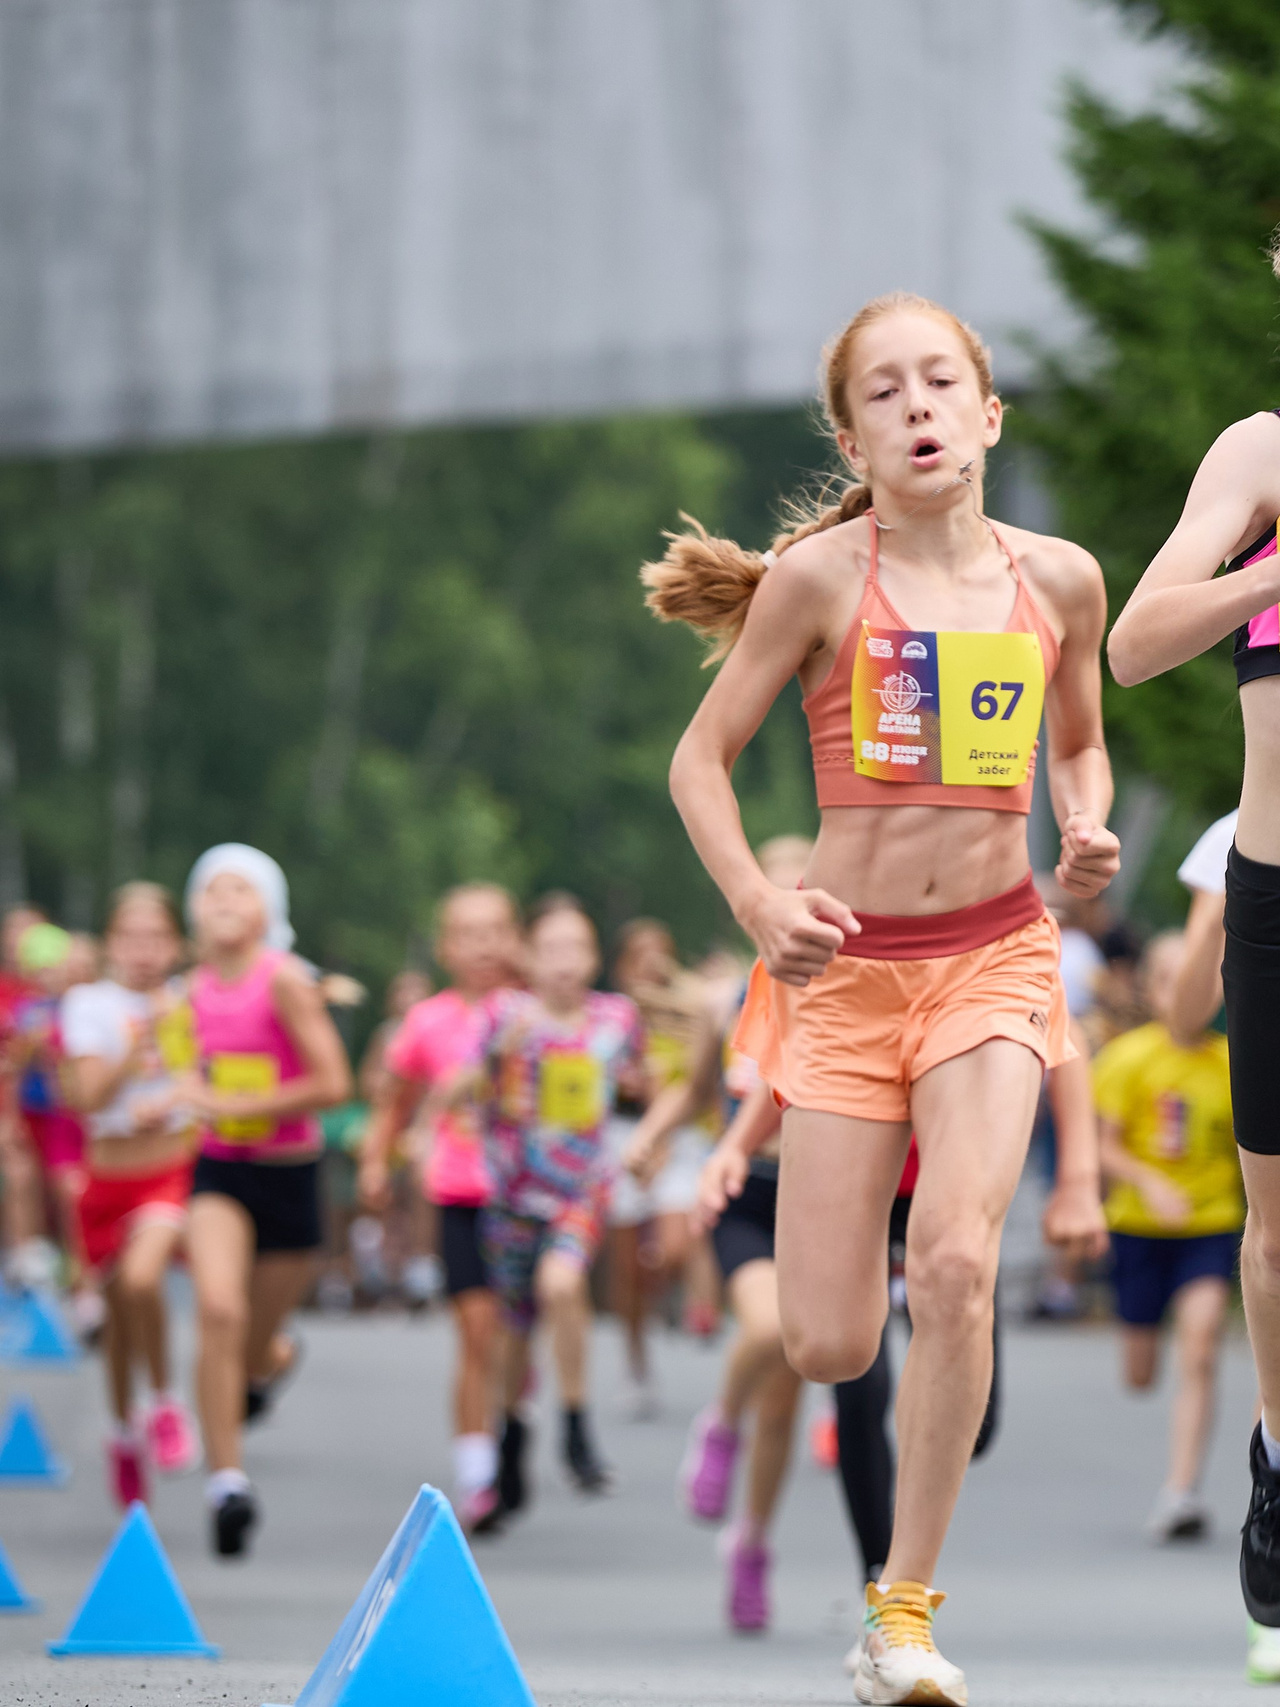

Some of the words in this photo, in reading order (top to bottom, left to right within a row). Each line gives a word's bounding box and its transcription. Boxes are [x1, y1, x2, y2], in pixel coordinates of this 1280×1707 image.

[971, 680, 1024, 720] 67
[879, 713, 921, 727] АРЕНА
[861, 740, 890, 762] 28
[969, 749, 1019, 760] Детский
[978, 765, 1011, 775] забег
